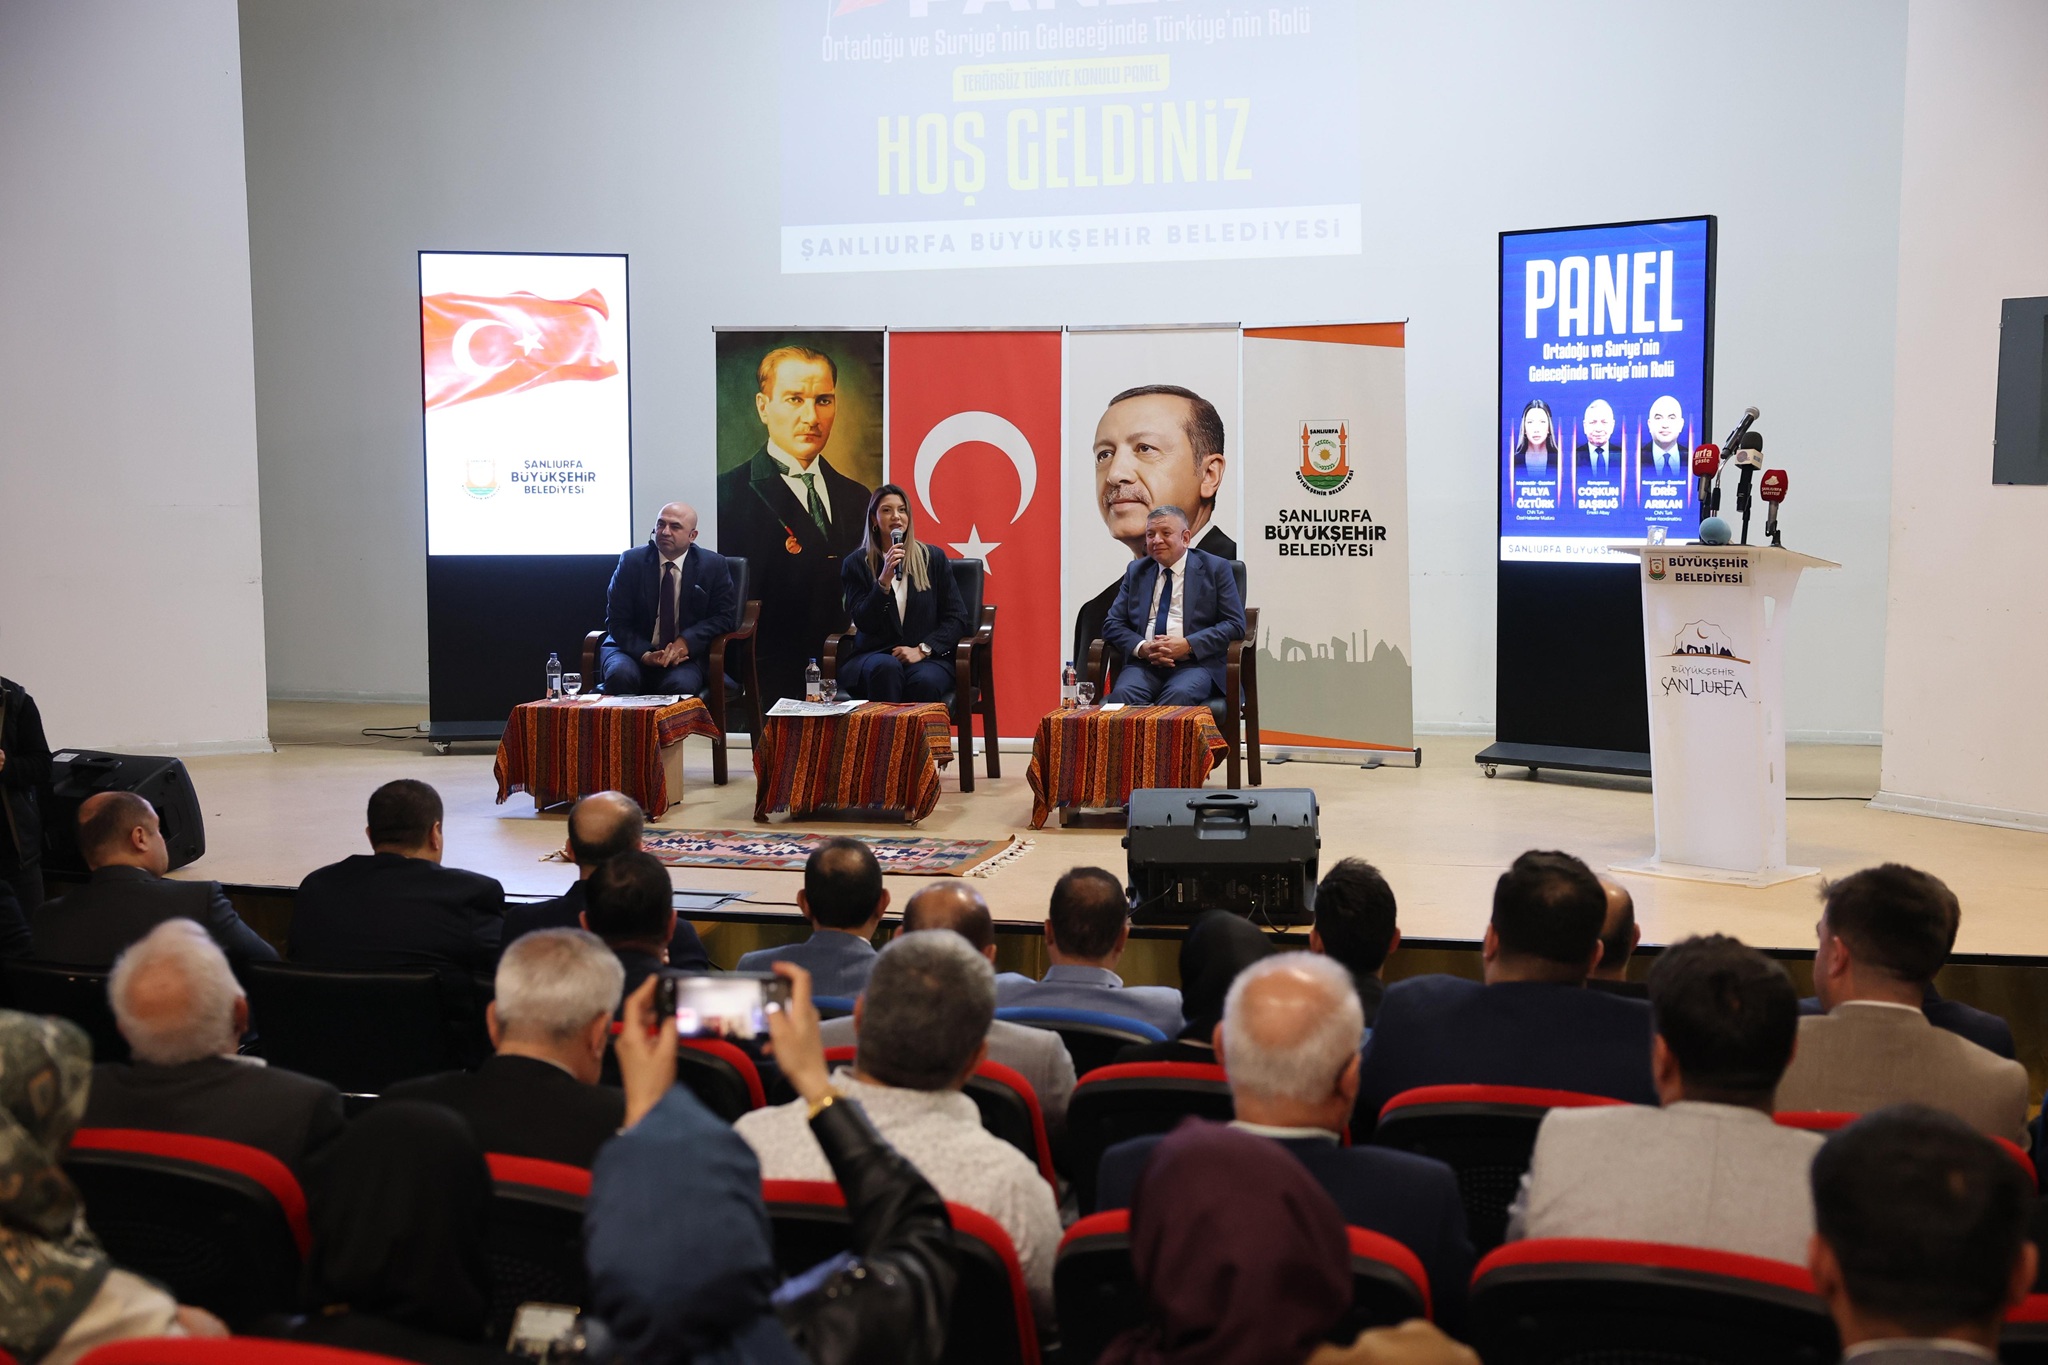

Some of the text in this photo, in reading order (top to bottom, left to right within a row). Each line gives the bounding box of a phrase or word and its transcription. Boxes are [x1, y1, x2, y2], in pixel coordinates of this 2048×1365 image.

[822, 32, 903, 63] Ortadoğu
[909, 37, 929, 57] ve
[935, 23, 1030, 58] Suriye'nin
[1036, 19, 1148, 51] Geleceğinde
[1153, 9, 1262, 45] Türkiye'nin
[1268, 7, 1312, 37] Rolü
[961, 64, 1161, 93] TERÖRSÜZ TÜRKİYE KONULU PANEL
[877, 97, 1253, 206] HOŞ GELDİNİZ
[799, 218, 1342, 260] ŞANLIURFA BÜYÜKŞEHİR BELEDİYESİ
[1525, 250, 1683, 339] PANEL
[1543, 338, 1660, 361] Ortadoğu ve Suriye'nin
[1529, 360, 1675, 384] Geleceğinde Türkiye'nin Rolü
[524, 460, 583, 469] ŞANLIURFA
[511, 471, 596, 483] BÜYÜKŞEHİR
[1295, 470, 1327, 496] BÜYÜKŞEHİR
[524, 485, 585, 494] BELEDİYESİ
[1521, 487, 1550, 496] FULYA
[1577, 487, 1619, 499] COŞKUN
[1650, 484, 1678, 496] İDRİS
[1516, 497, 1555, 509] ÖZTÜRK
[1578, 497, 1619, 511] BAŞBUĞ
[1644, 499, 1683, 509] ARIKAN
[1279, 509, 1372, 524] ŞANLIURFA
[1265, 525, 1387, 542] BÜYÜKŞEHİR
[1279, 543, 1373, 556] BELEDİYESİ
[1669, 555, 1749, 570] BÜYÜKŞEHİR
[1675, 571, 1743, 583] BELEDİYESİ
[1671, 665, 1735, 677] BÜYÜKŞEHİR
[1661, 676, 1747, 698] ŞANLIURFA
